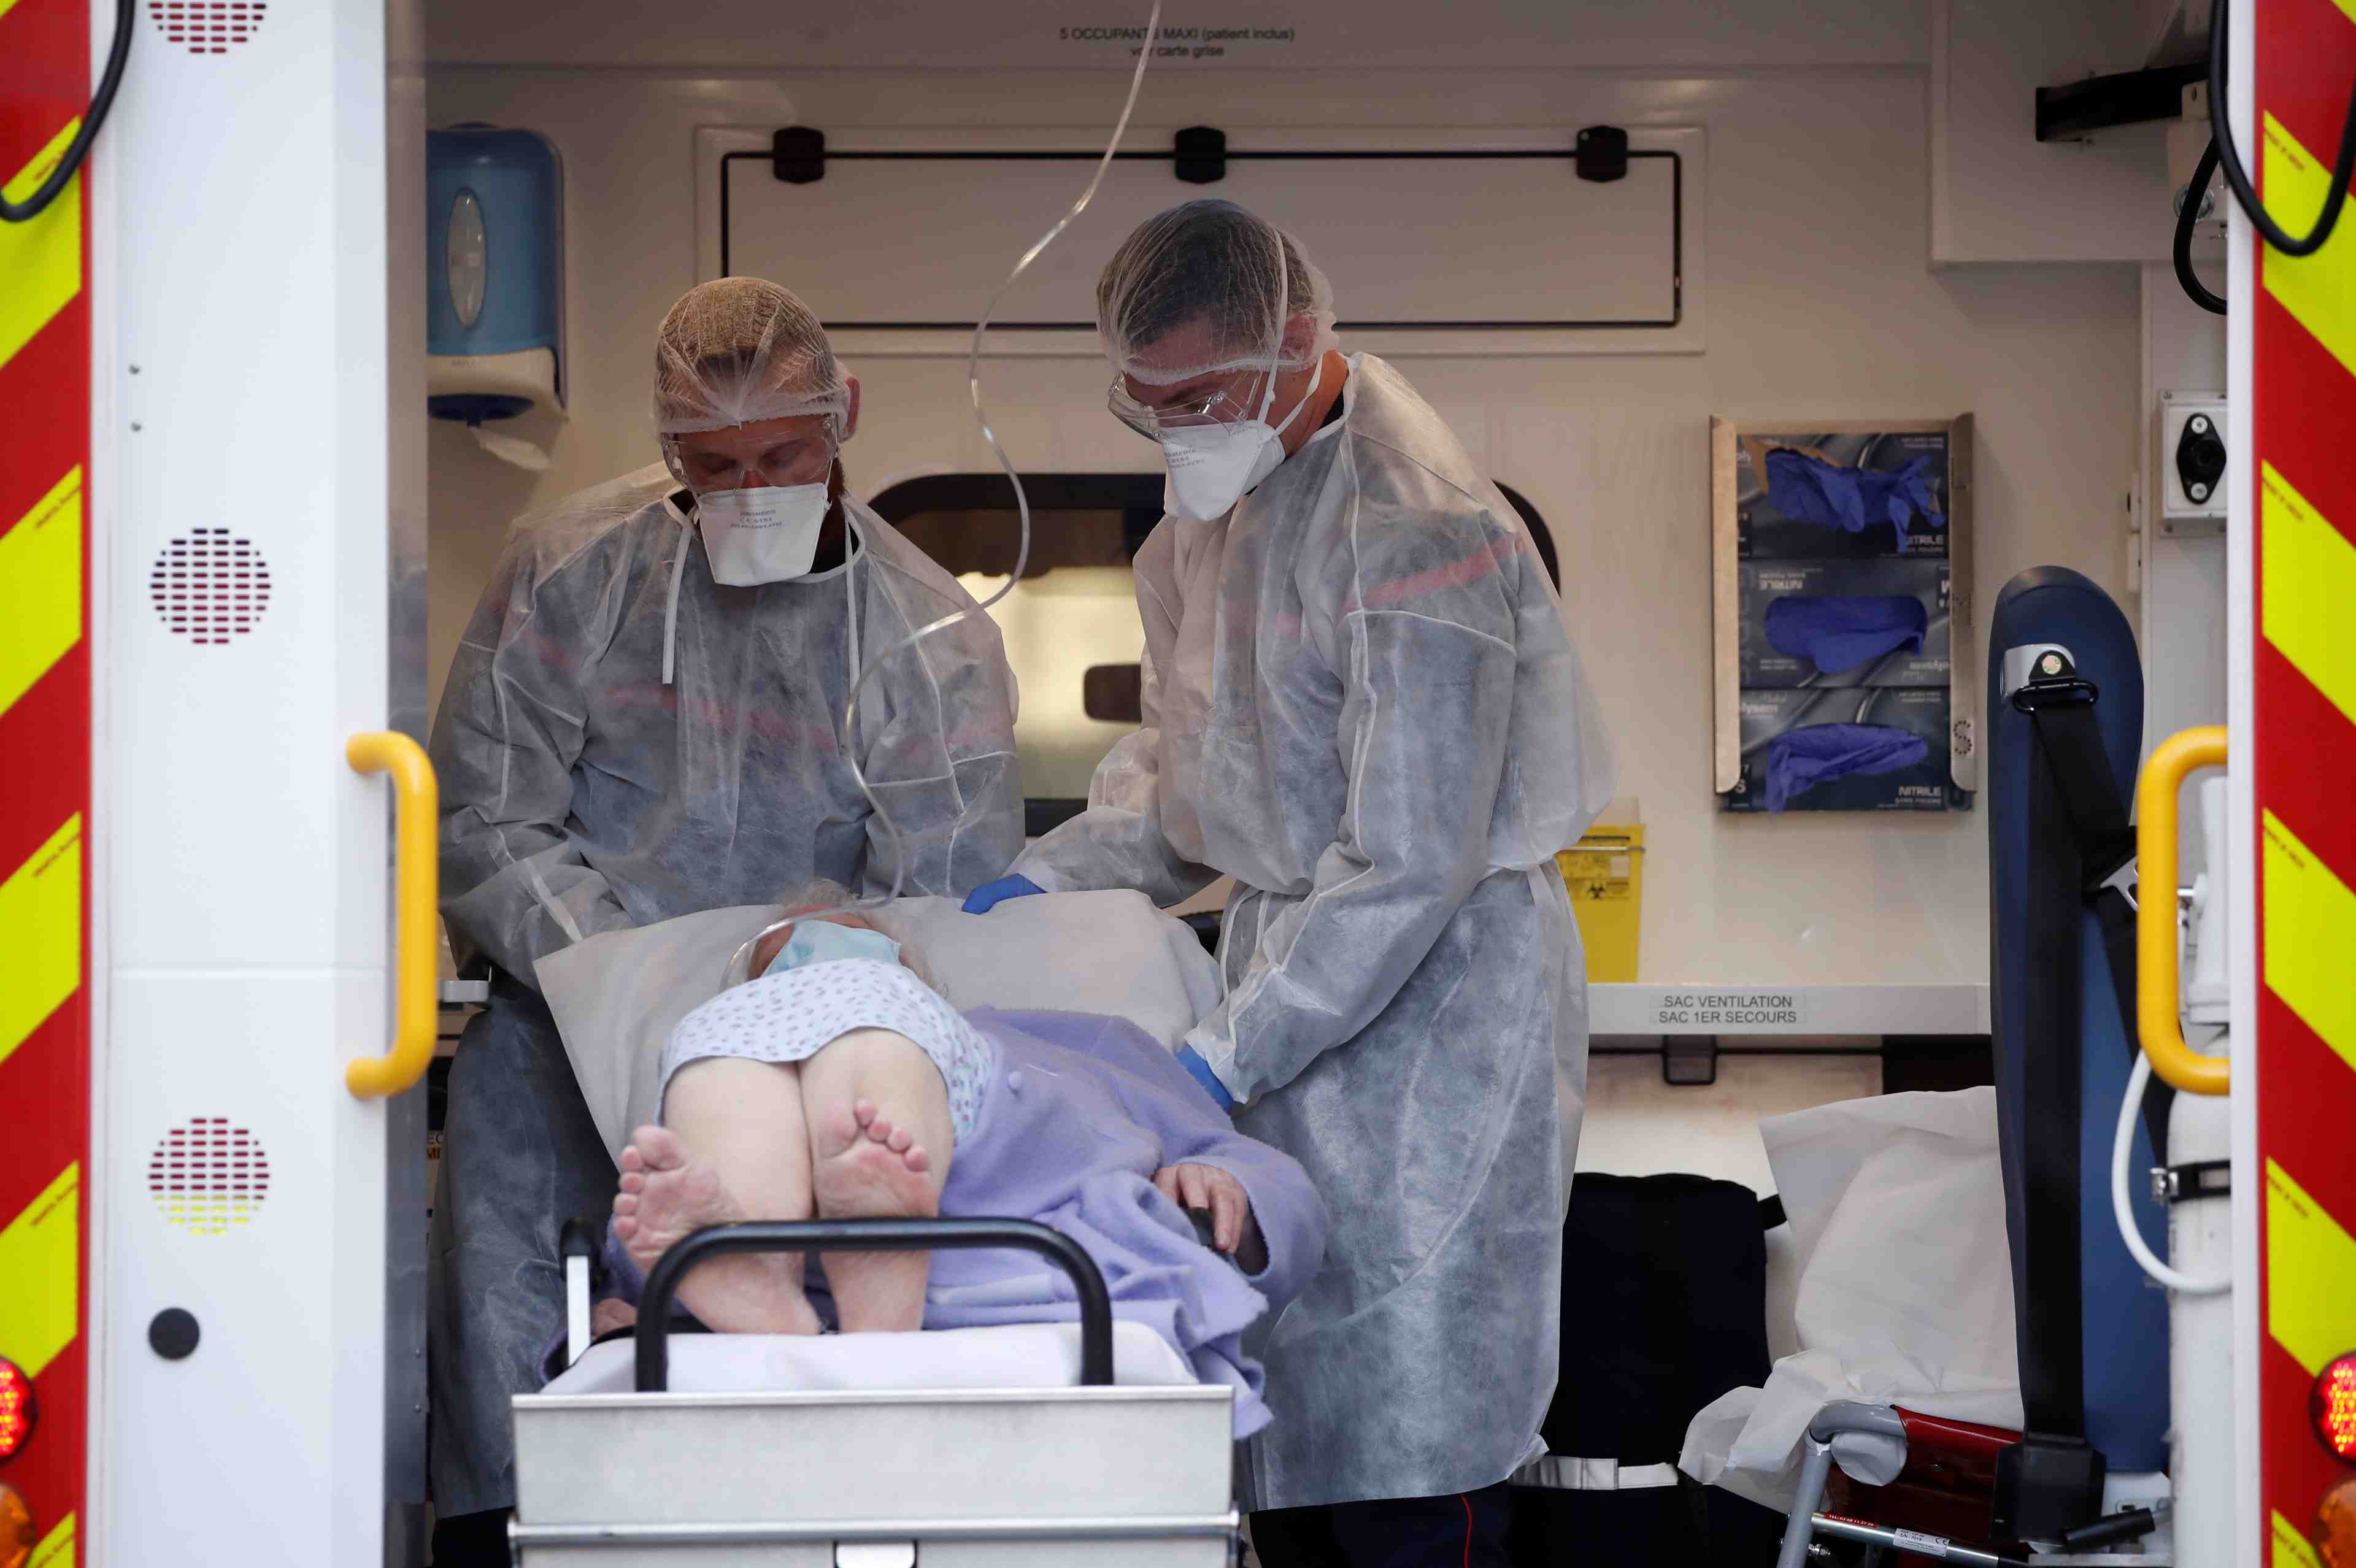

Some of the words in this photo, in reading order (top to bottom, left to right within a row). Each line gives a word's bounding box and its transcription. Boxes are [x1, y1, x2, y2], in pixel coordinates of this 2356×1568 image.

[1060, 28, 1068, 40] 5
[1165, 28, 1199, 40] MAXI
[1202, 28, 1249, 41] (patient
[1253, 28, 1295, 41] inclus)
[1130, 45, 1153, 56] vor
[1157, 45, 1188, 56] carte
[1193, 45, 1225, 58] grise
[1954, 720, 1973, 755] S
[1898, 786, 1941, 796] NITRILE
[1664, 996, 1694, 1008] SAC
[1698, 996, 1792, 1008] VENTILATION
[1658, 1011, 1688, 1023] SAC
[1694, 1011, 1720, 1023] 1ER
[1725, 1011, 1797, 1023] SECOURS
